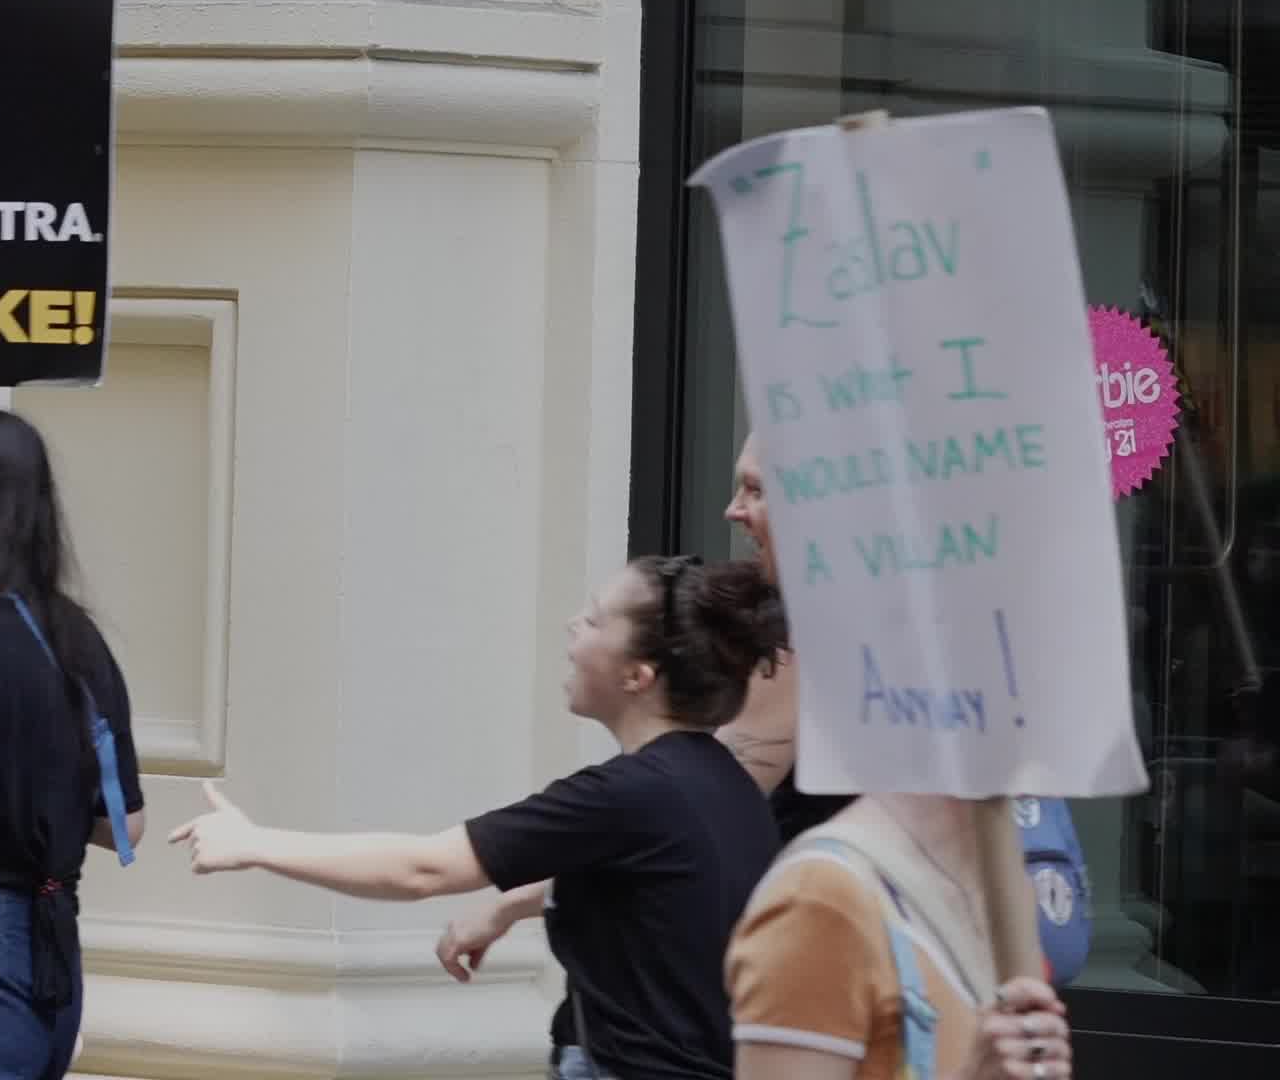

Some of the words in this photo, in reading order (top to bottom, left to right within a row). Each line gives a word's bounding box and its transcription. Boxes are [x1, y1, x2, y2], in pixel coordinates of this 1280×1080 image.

[938, 336, 1009, 402] I
[904, 423, 1048, 482] NAME
[1114, 428, 1136, 457] 21
[804, 539, 834, 585] A
